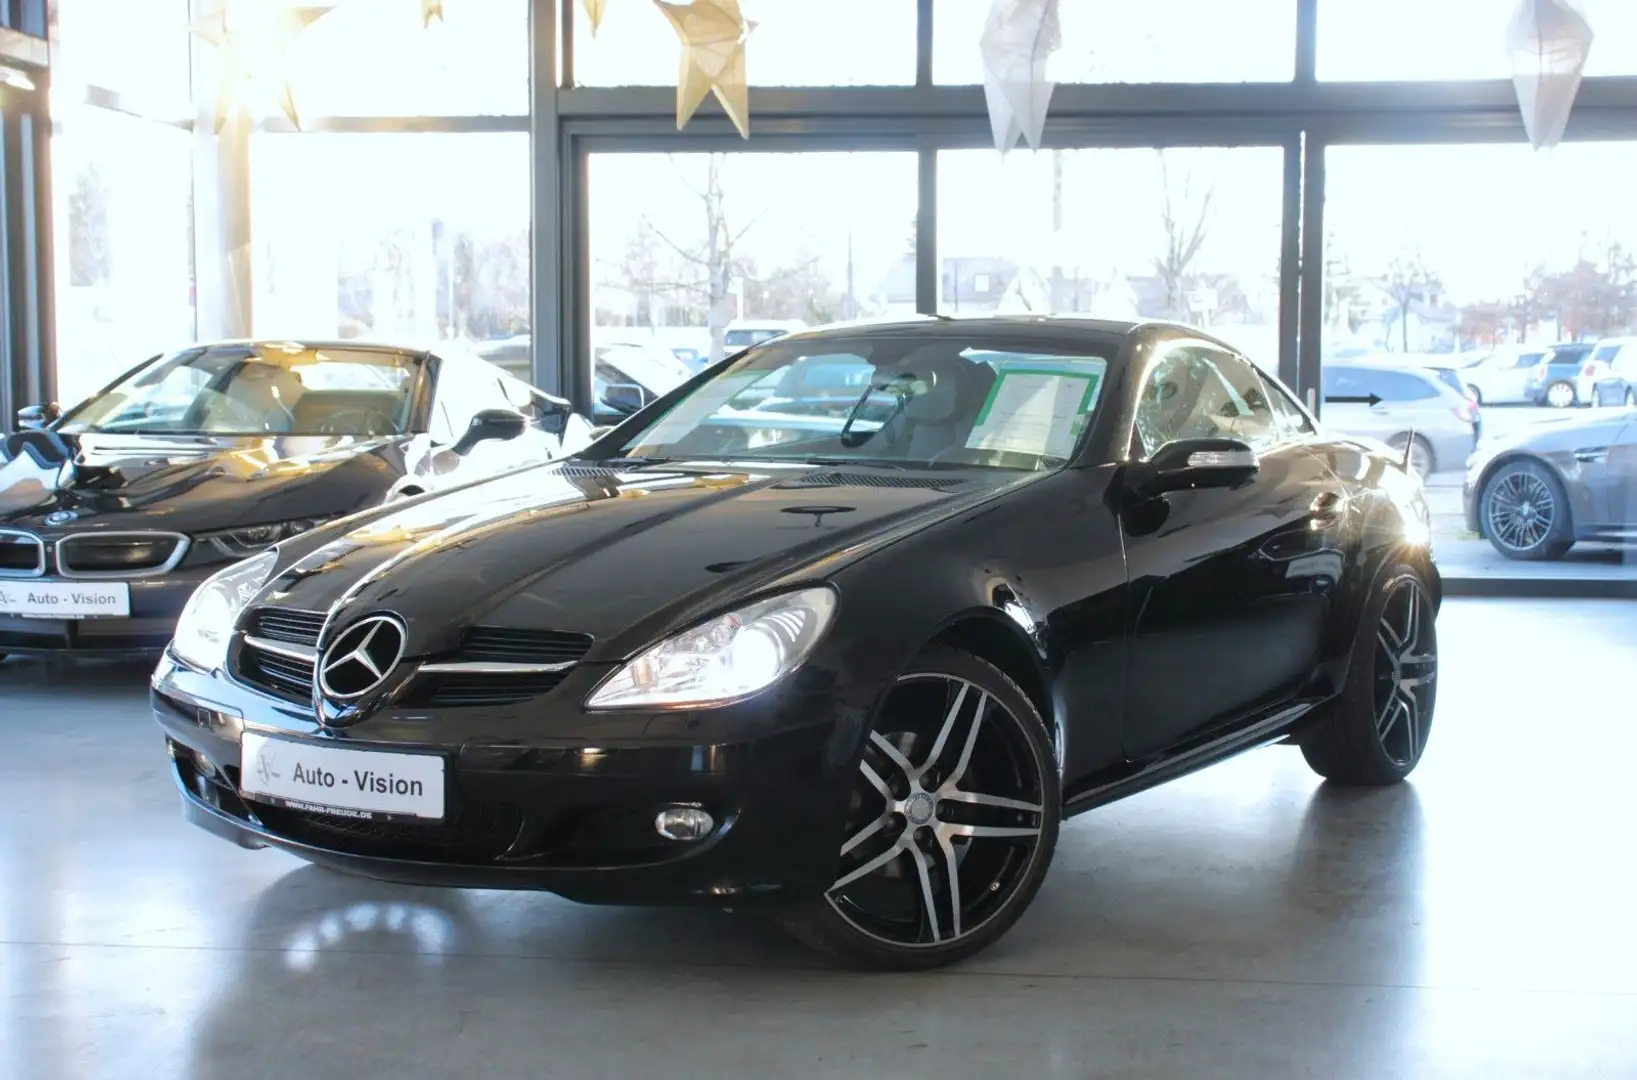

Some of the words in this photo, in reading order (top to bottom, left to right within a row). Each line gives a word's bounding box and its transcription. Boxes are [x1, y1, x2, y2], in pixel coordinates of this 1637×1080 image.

[27, 592, 59, 604] Auto
[71, 592, 116, 604] Vision
[293, 762, 335, 788] Auto
[353, 770, 423, 797] Vision
